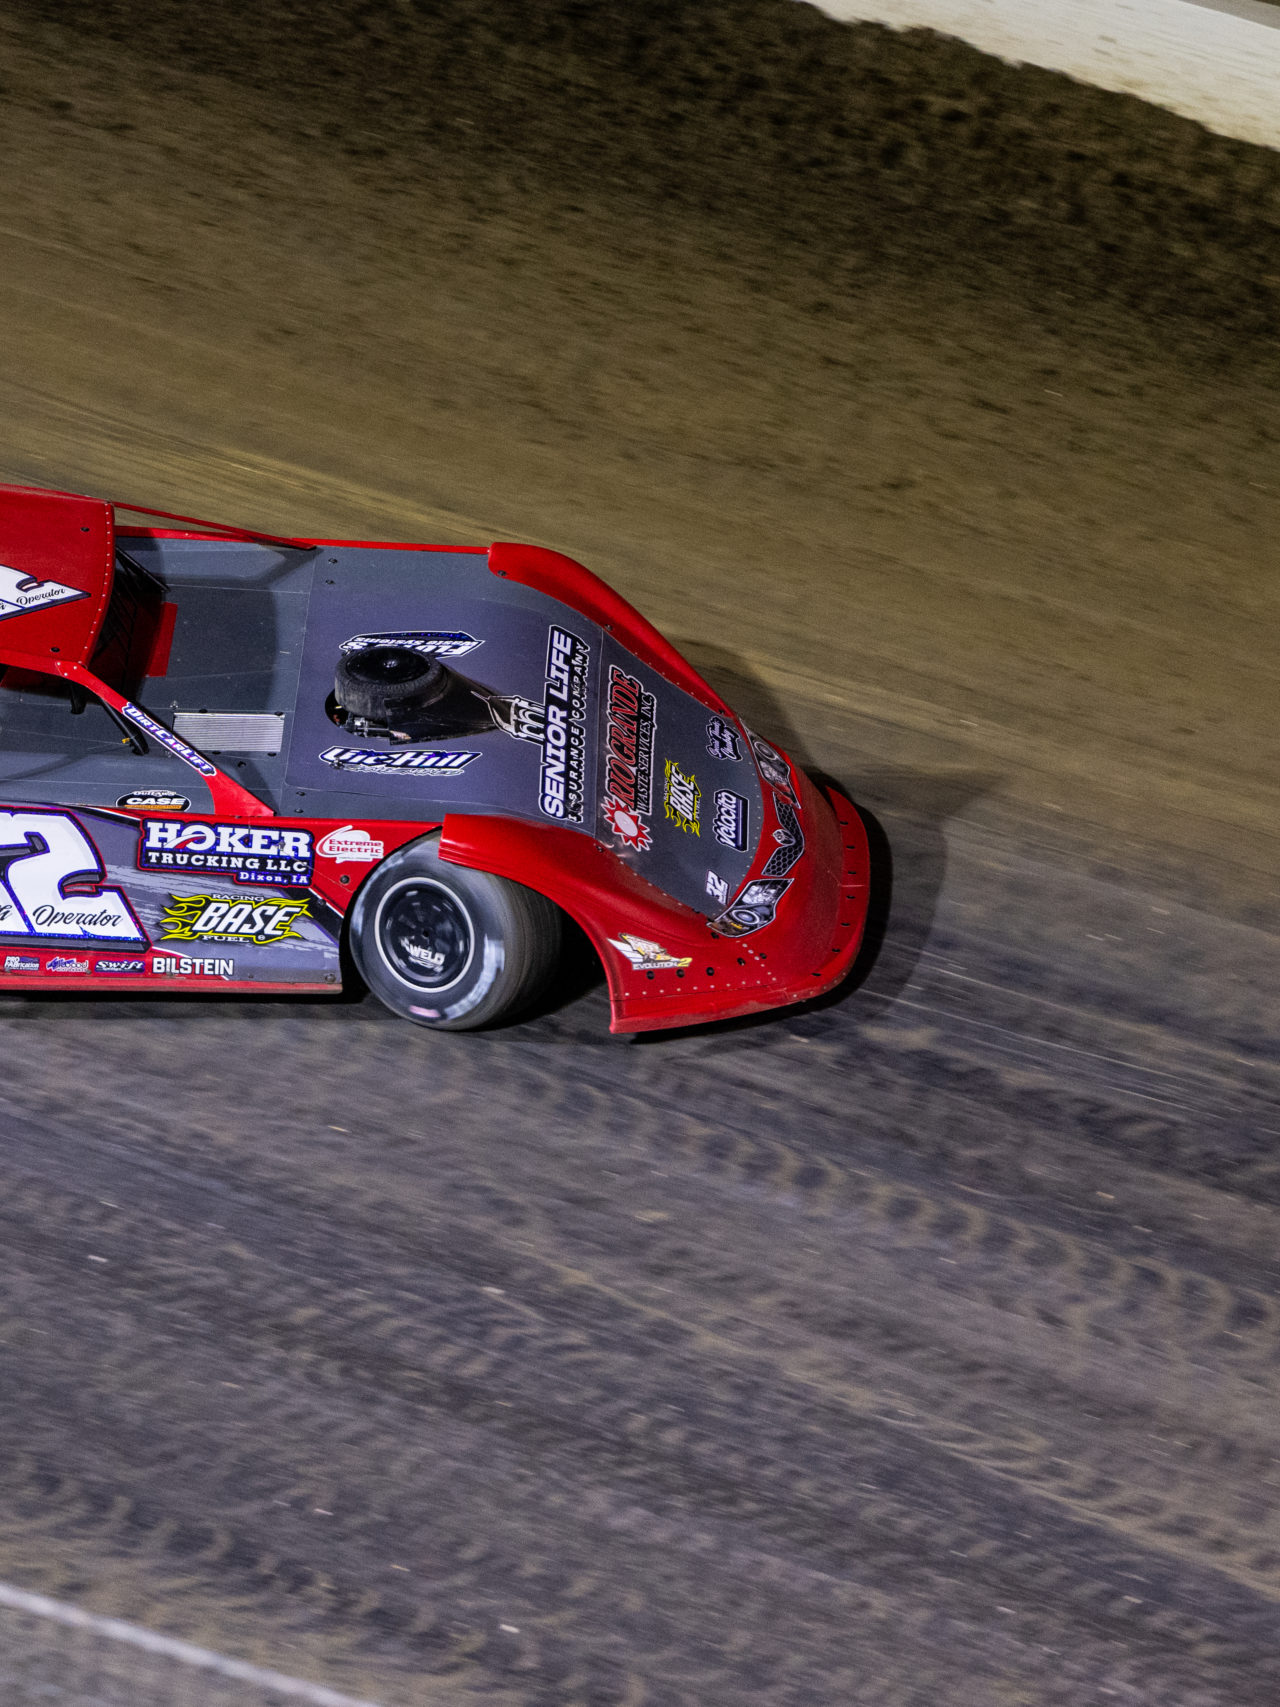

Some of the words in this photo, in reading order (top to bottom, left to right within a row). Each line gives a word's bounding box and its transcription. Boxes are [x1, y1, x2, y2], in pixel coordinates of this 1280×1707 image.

[16, 587, 66, 606] Operator
[549, 630, 572, 701] LIFE
[543, 704, 568, 818] SENIOR
[126, 797, 186, 806] CASE
[636, 773, 650, 812] WASTE
[670, 764, 694, 821] BASE
[145, 821, 312, 858] HOKER
[328, 839, 382, 847] Extreme
[328, 846, 382, 854] Electric
[148, 851, 261, 869] TRUCKING
[266, 859, 308, 872] LLC
[239, 871, 288, 884] Dixon,
[292, 875, 309, 884] IA
[211, 893, 264, 902] RACING
[706, 870, 729, 906] 32
[32, 904, 124, 928] Operator
[192, 902, 302, 935] BASE
[202, 935, 250, 943] FUEL
[410, 943, 446, 966] WELD
[632, 961, 677, 970] EVOLUTION
[677, 957, 693, 967] 2
[96, 960, 144, 970] Swift
[152, 957, 234, 976] BILSTEIN
